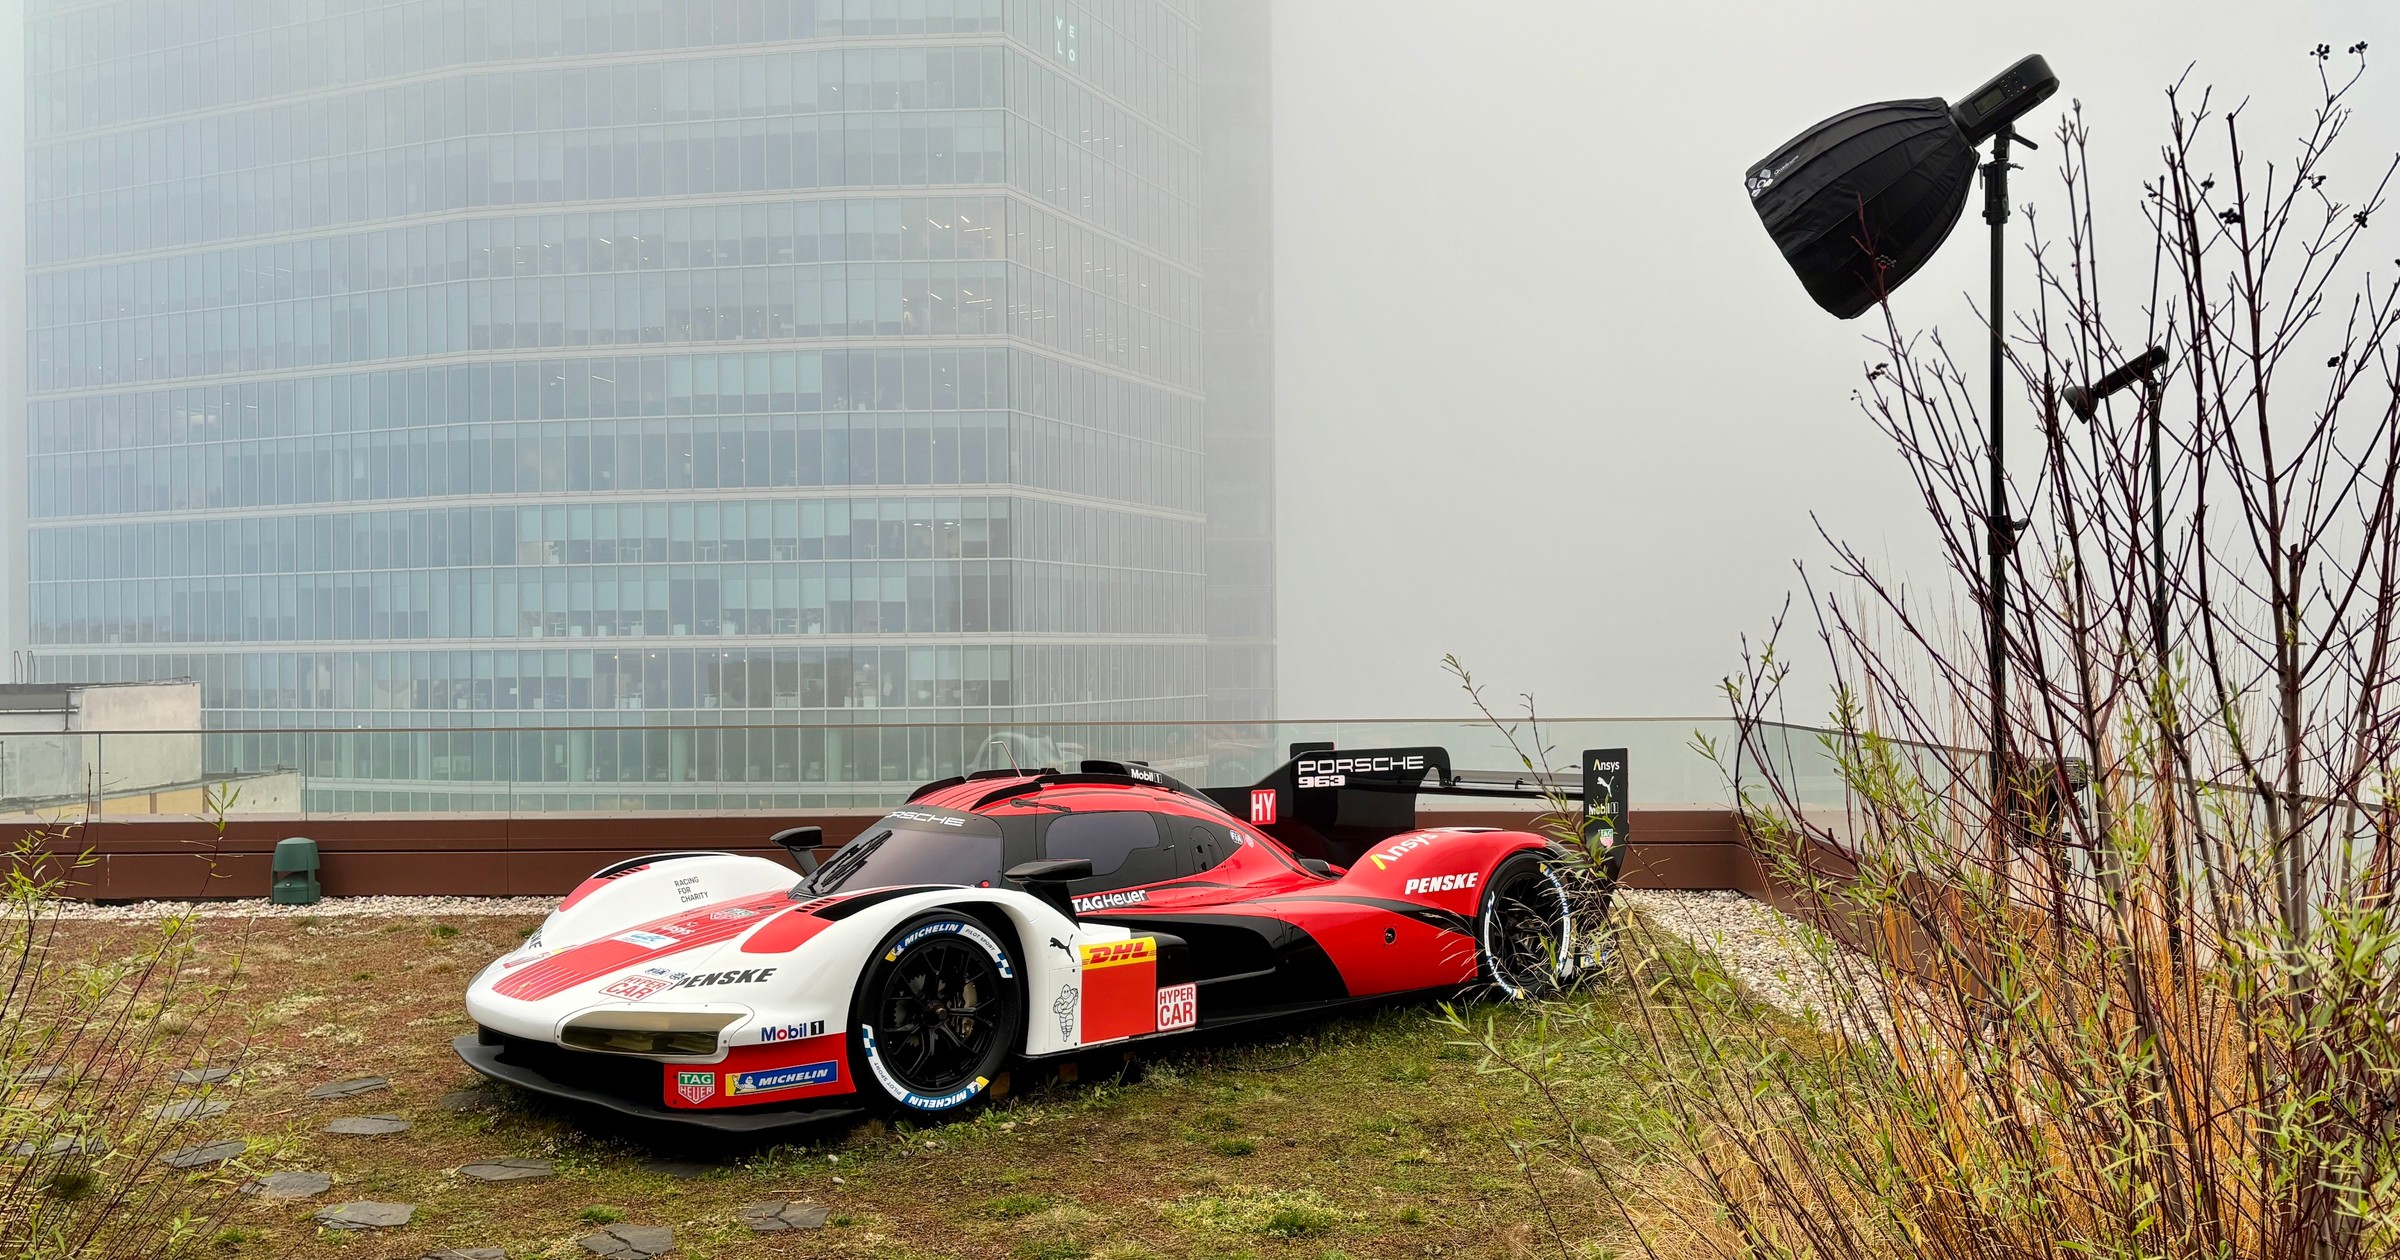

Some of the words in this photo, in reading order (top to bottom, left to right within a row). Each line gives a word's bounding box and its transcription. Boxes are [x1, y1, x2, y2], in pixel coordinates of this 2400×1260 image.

[1298, 755, 1424, 776] PORSCHE
[1593, 759, 1620, 773] Ansys
[1131, 769, 1154, 782] Mobil
[1154, 772, 1163, 784] 1
[1298, 775, 1346, 788] 963
[1252, 792, 1275, 822] HY
[1369, 833, 1439, 871] Ansys
[674, 876, 699, 887] RACING
[678, 886, 692, 895] FOR
[1404, 872, 1479, 895] PENSKE
[681, 891, 708, 903] CHARITY
[904, 923, 959, 947] MICHELIN
[965, 928, 977, 938] PILOT
[980, 936, 996, 951] SPORT
[1089, 942, 1149, 964] DHL
[624, 976, 665, 990] HYPER
[667, 968, 777, 991] PENSKE
[606, 983, 653, 999] CAR
[1159, 987, 1193, 1005] HYPER
[1160, 1001, 1193, 1027] CAR
[761, 1023, 807, 1042] Mobil
[812, 1021, 823, 1035] 1
[681, 1073, 711, 1084] TAG
[758, 1068, 828, 1086] MICHELIN
[874, 1062, 888, 1082] SPORT
[680, 1086, 713, 1101] HEUER
[887, 1081, 902, 1096] PILOT
[908, 1090, 967, 1108] MICHELIN
